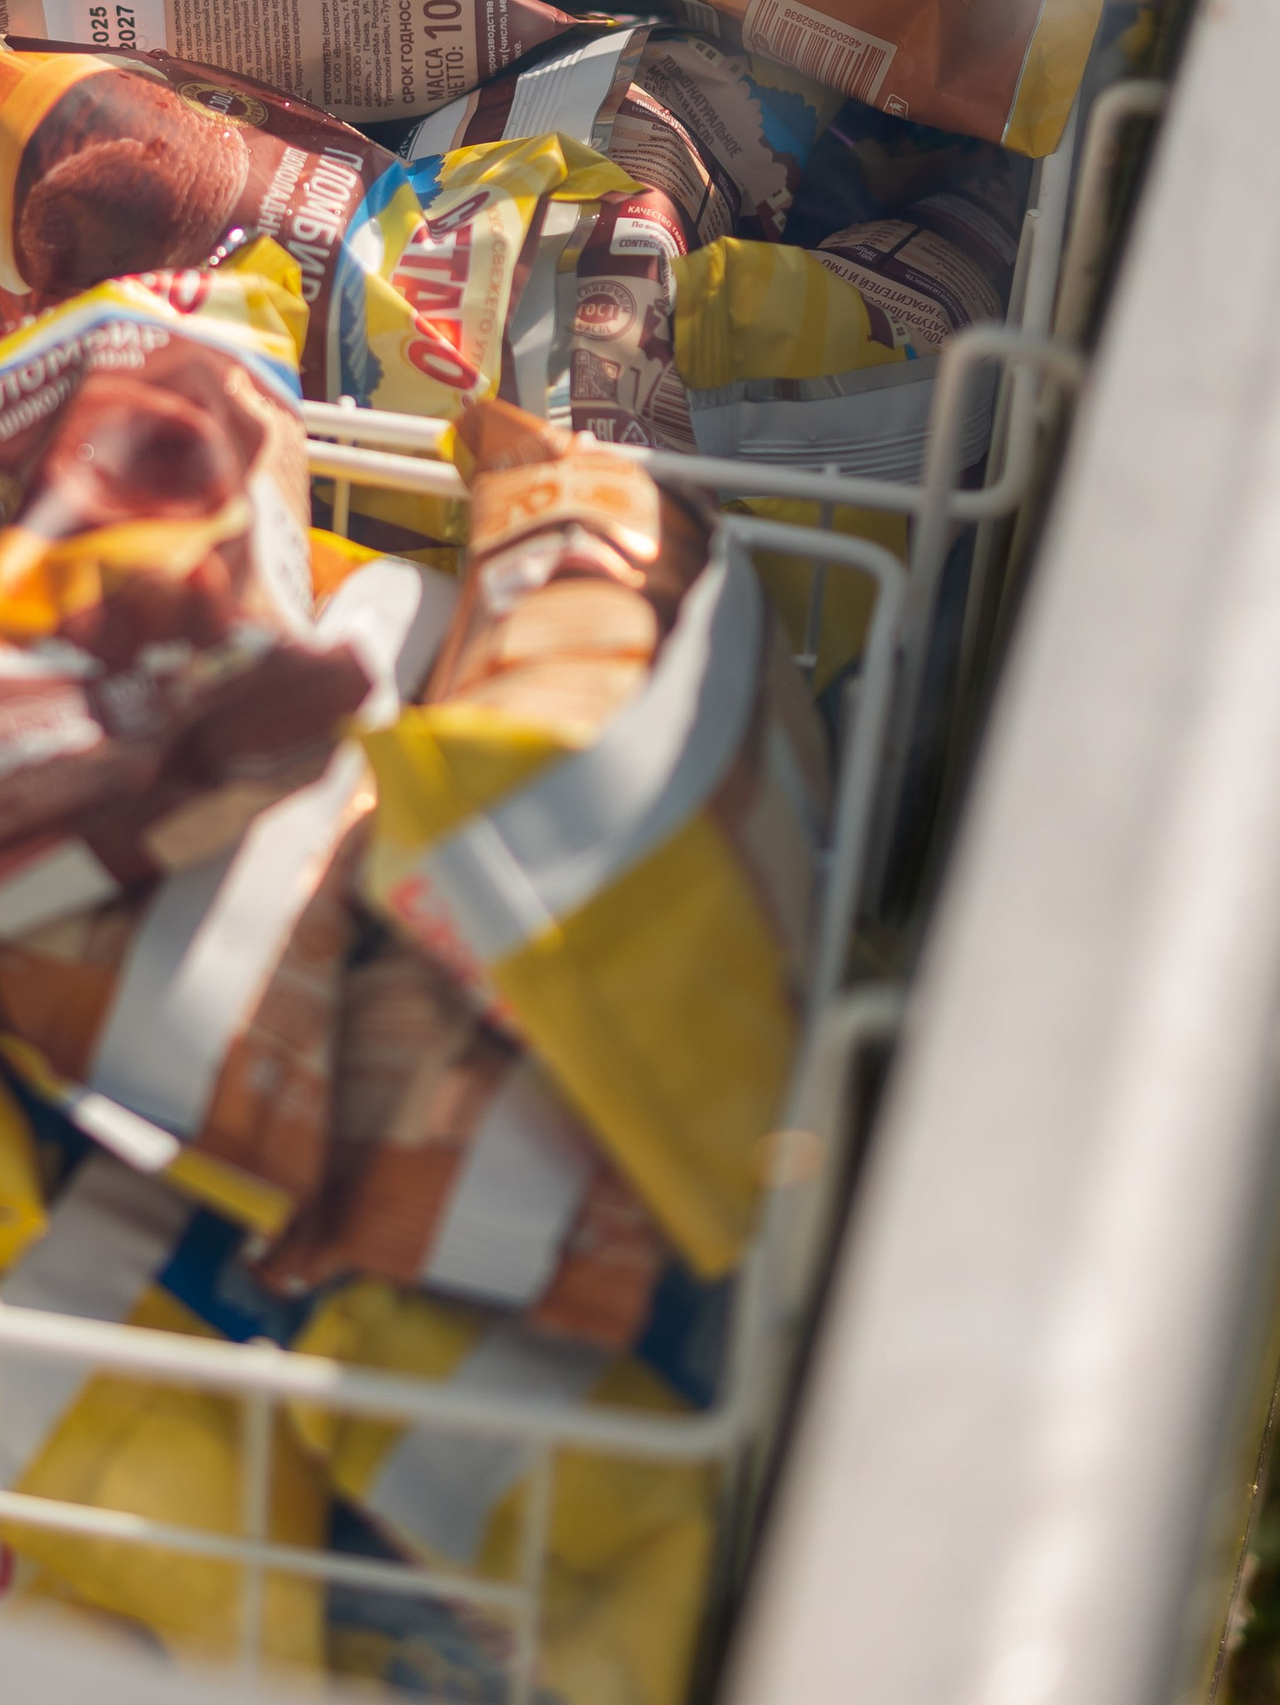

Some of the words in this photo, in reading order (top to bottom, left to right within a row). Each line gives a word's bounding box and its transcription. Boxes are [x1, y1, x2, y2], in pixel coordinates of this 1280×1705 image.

[172, 0, 182, 35] цельное
[271, 11, 280, 36] следы
[321, 2, 330, 35] (смотри
[362, 1, 370, 14] ул.
[382, 14, 390, 23] г.
[193, 21, 203, 46] сухой,
[202, 8, 212, 51] глюкозный
[241, 0, 251, 62] картофельный
[262, 16, 273, 74] разрыхлитель
[281, 22, 291, 70] ХРАНЕНИЯ:
[341, 12, 351, 50] область,
[351, 7, 361, 52] «Ледяной
[363, 18, 371, 51] Пенза,
[382, 25, 391, 53] район,
[498, 9, 509, 53] (число,
[783, 8, 862, 49] 4620032652938
[253, 29, 262, 65] лецитин
[273, 38, 282, 82] содержать
[292, 35, 301, 58] после
[293, 60, 302, 89] Продукт
[353, 55, 361, 76] ООО
[425, 46, 444, 101] МАССА
[400, 65, 414, 103] СРОК
[205, 90, 234, 115] ГОСТ
[686, 84, 742, 157] НАТУРАЛЬНОЕ
[628, 205, 673, 227] КАЧЕСТВО
[847, 270, 859, 283] И
[857, 275, 936, 316] КРАСИТЕЛЕЙ
